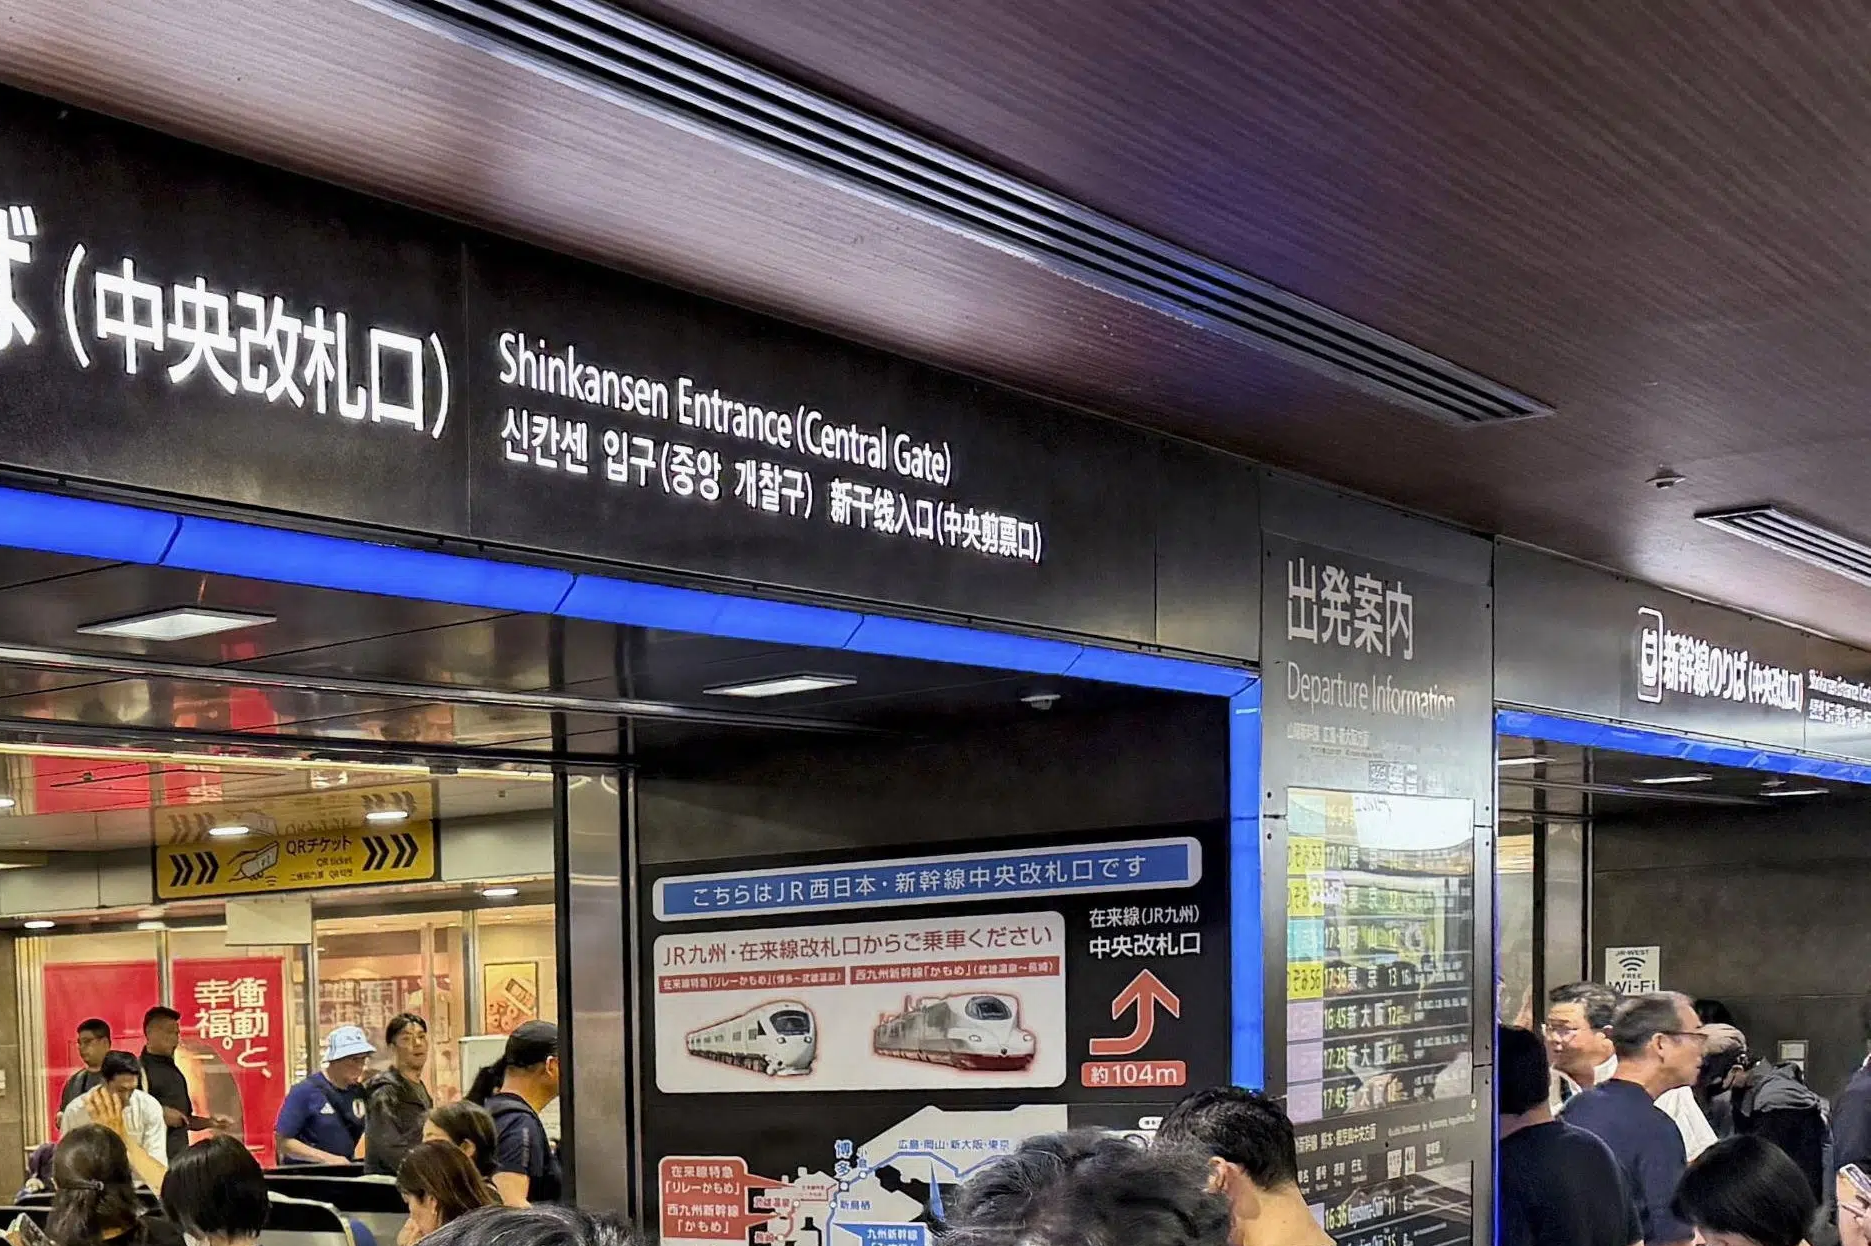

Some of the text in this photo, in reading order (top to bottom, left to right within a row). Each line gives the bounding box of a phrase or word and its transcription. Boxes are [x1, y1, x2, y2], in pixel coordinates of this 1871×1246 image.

[63, 243, 451, 440] (中央改札口)
[499, 332, 952, 487] Shinkansen Entrance (Central Gate)
[501, 407, 814, 520] 신칸센 입구(중앙 개찰구)
[830, 478, 1043, 563] 新干线入口(中央剪票口)
[1287, 557, 1414, 660] 出発案内
[1663, 630, 1749, 701] 新幹線のりば
[1288, 661, 1456, 722] Departure Information
[286, 835, 353, 857] QRチケット
[692, 855, 1147, 908] こちらはJR西日本・新幹線中央改札口です
[1088, 903, 1201, 926] 在来線(JR九州)
[663, 924, 1053, 967] JR九州・在来線改札口からご乗車ください
[1088, 932, 1202, 959] 中央改札口
[194, 979, 234, 1051] 幸福。
[232, 979, 272, 1079] 衝動と、
[1090, 1064, 1179, 1086] 約104m
[834, 1139, 854, 1178] 博多
[897, 1138, 1010, 1151] 広島・岡山・新大阪・東京
[665, 1181, 740, 1196] 「リレーかもめ」
[670, 1165, 734, 1178] 在来線特急
[667, 1203, 739, 1218] 西九州新幹線
[677, 1220, 730, 1234] 「かもめ」
[866, 1228, 918, 1241] 九州新幹線
